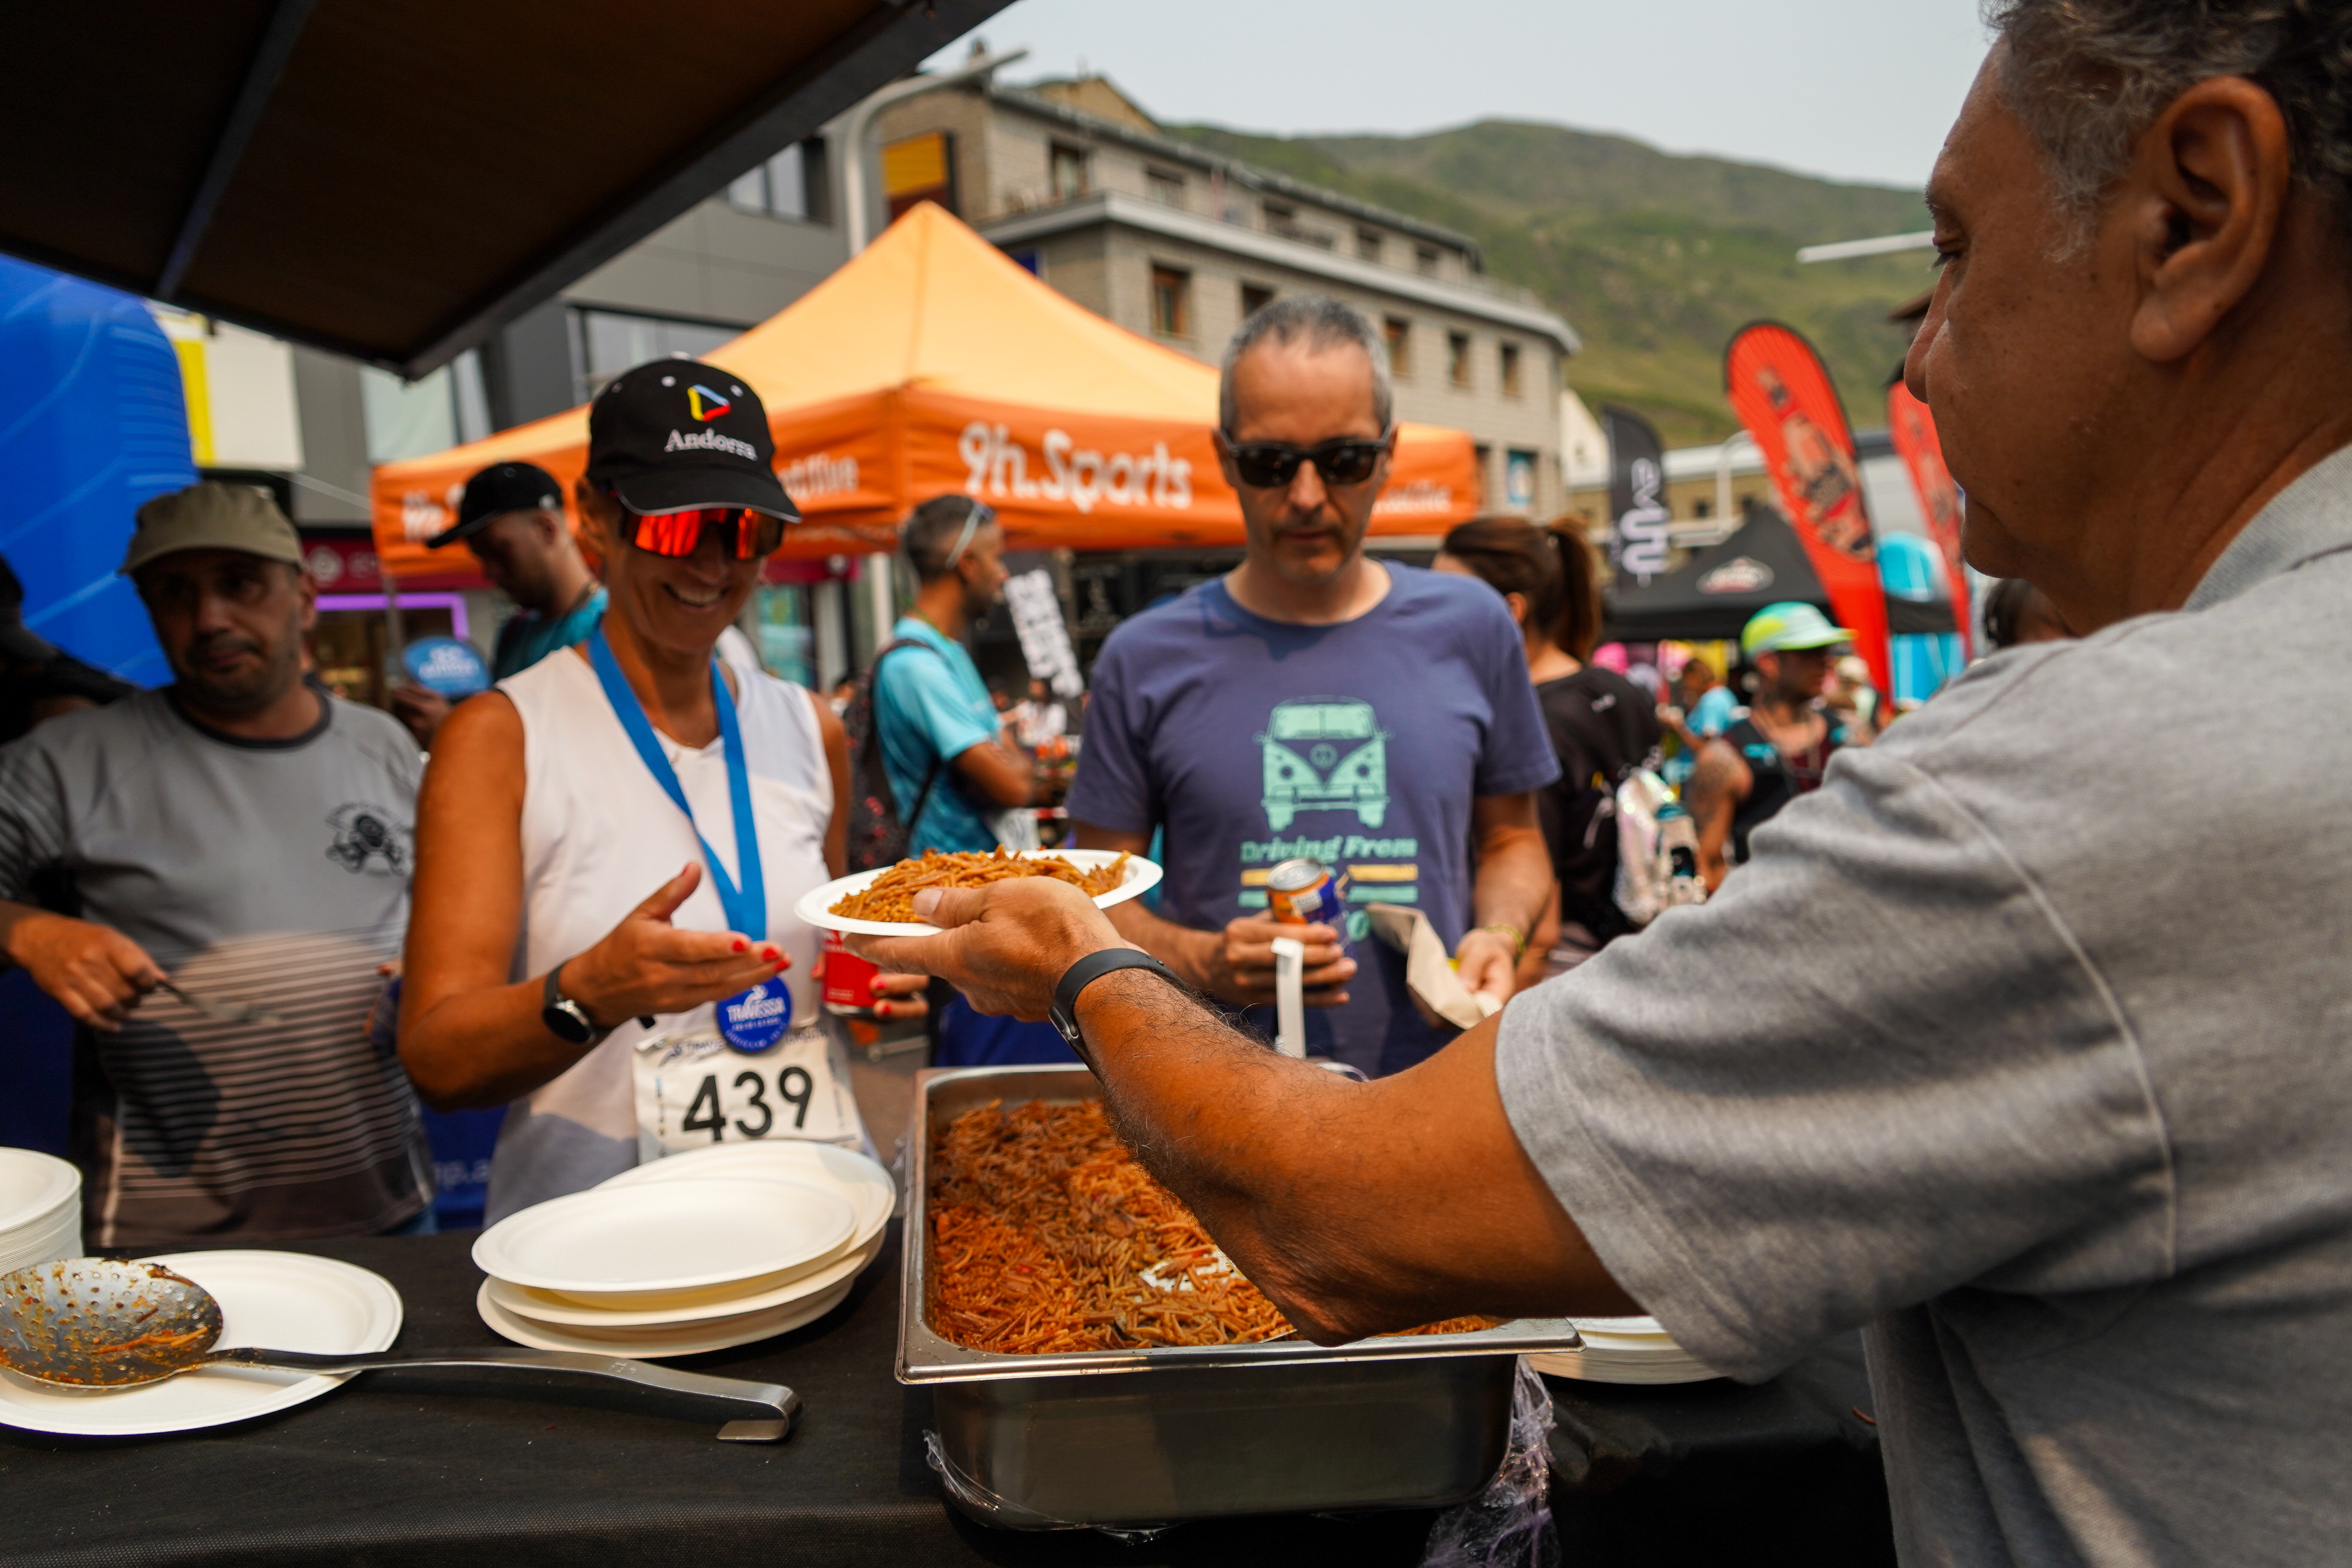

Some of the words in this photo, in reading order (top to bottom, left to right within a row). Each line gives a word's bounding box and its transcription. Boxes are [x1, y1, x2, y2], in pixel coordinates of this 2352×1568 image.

[664, 428, 758, 461] Andorra
[1239, 835, 1343, 865] Driving
[1343, 835, 1419, 859] From
[683, 1067, 812, 1142] 439
